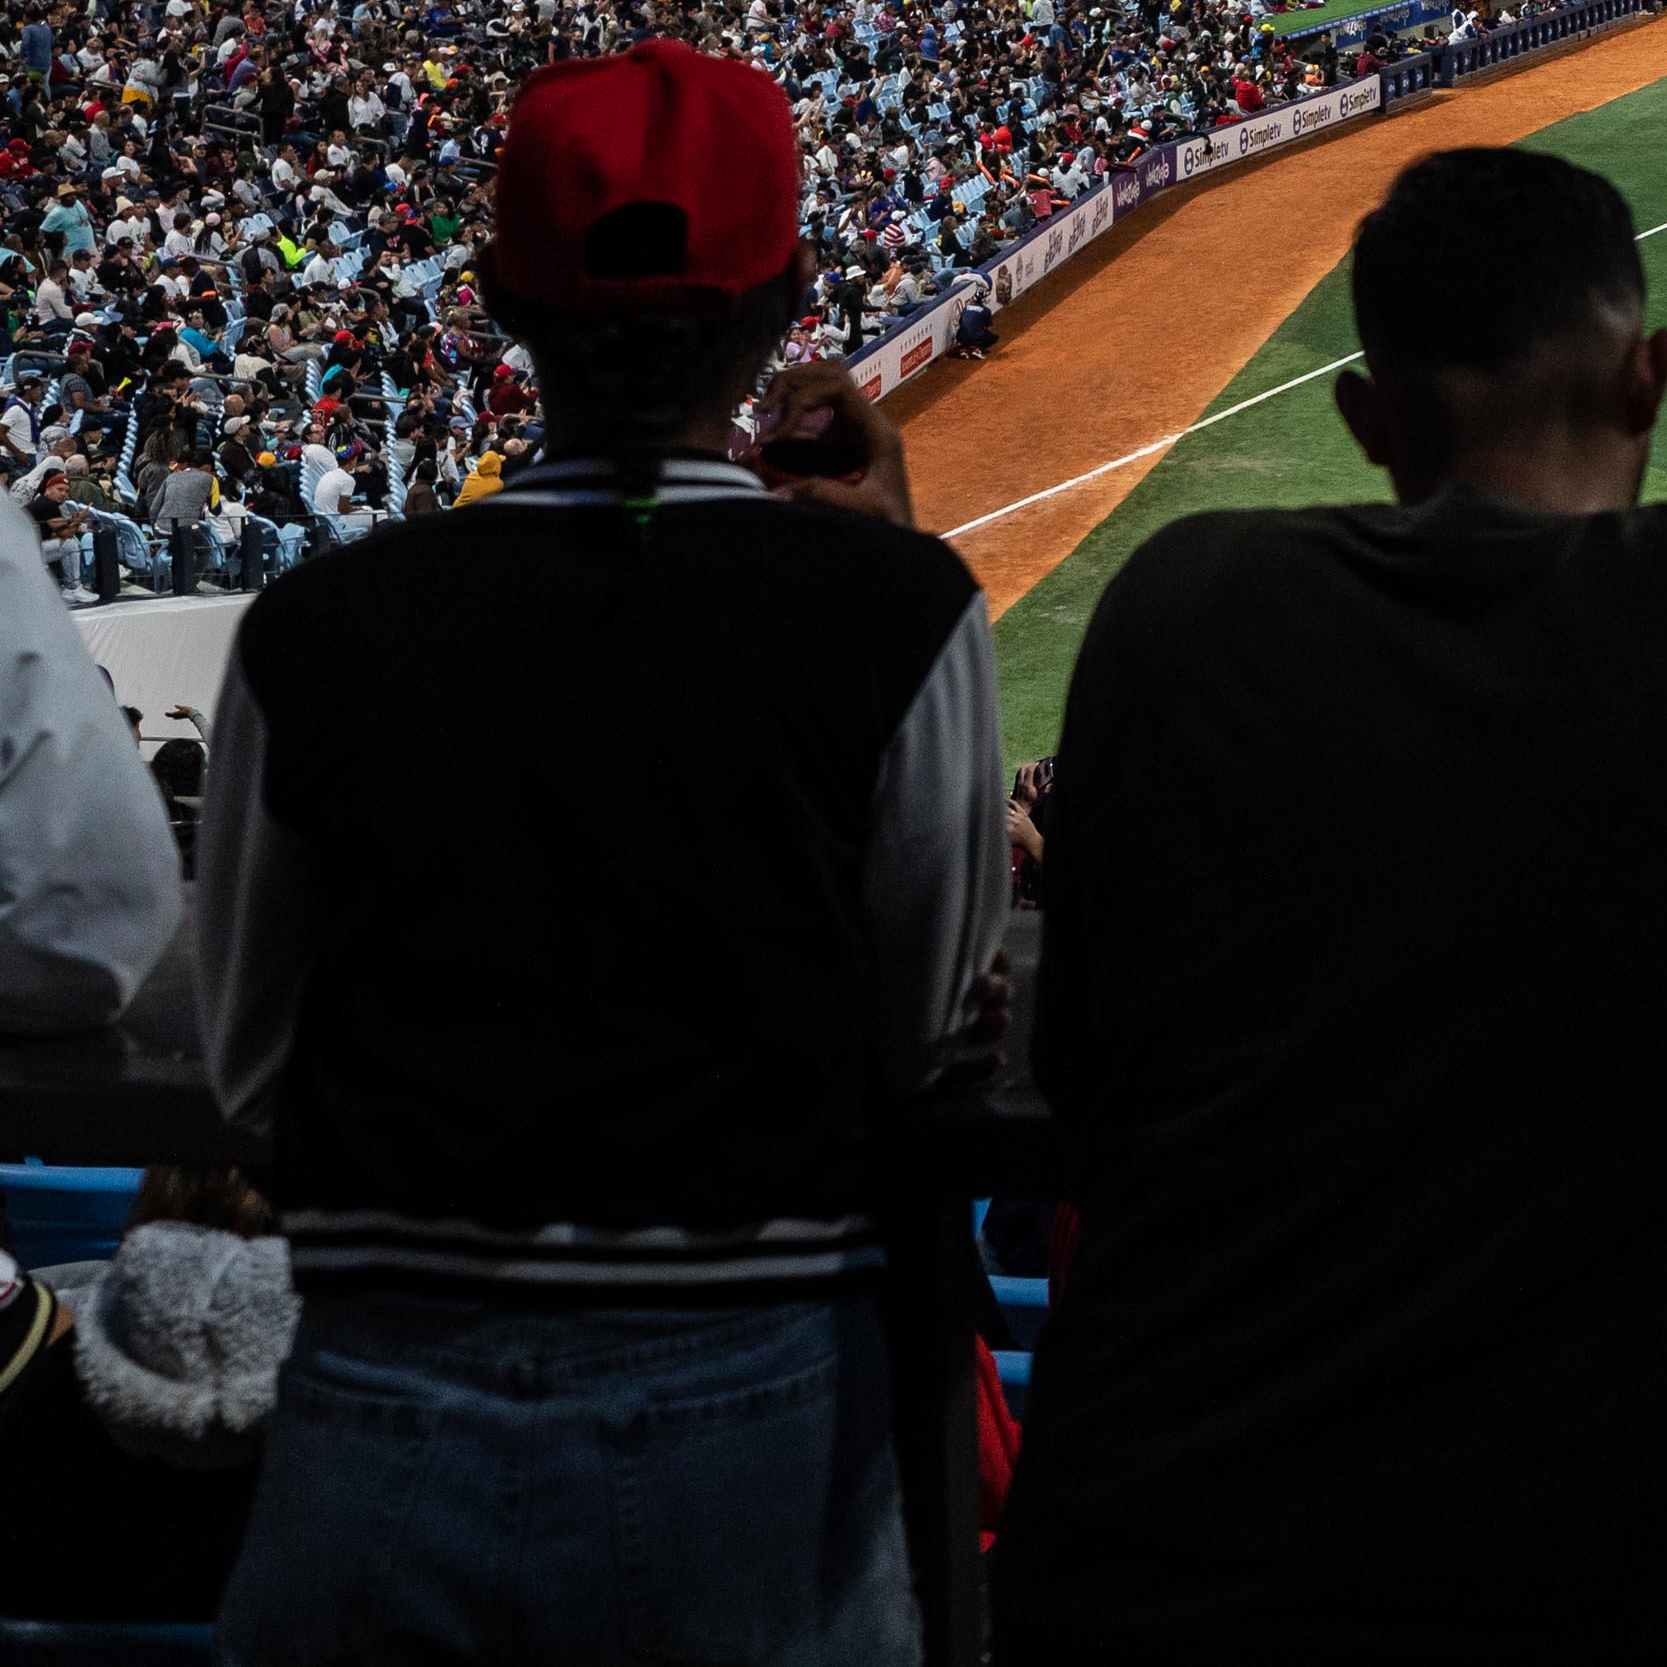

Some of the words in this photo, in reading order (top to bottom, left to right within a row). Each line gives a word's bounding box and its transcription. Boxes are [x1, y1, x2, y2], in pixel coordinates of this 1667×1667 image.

[1349, 85, 1377, 109] Simpletv
[1302, 104, 1332, 128] Simpletv
[1249, 122, 1282, 148] Simpletv
